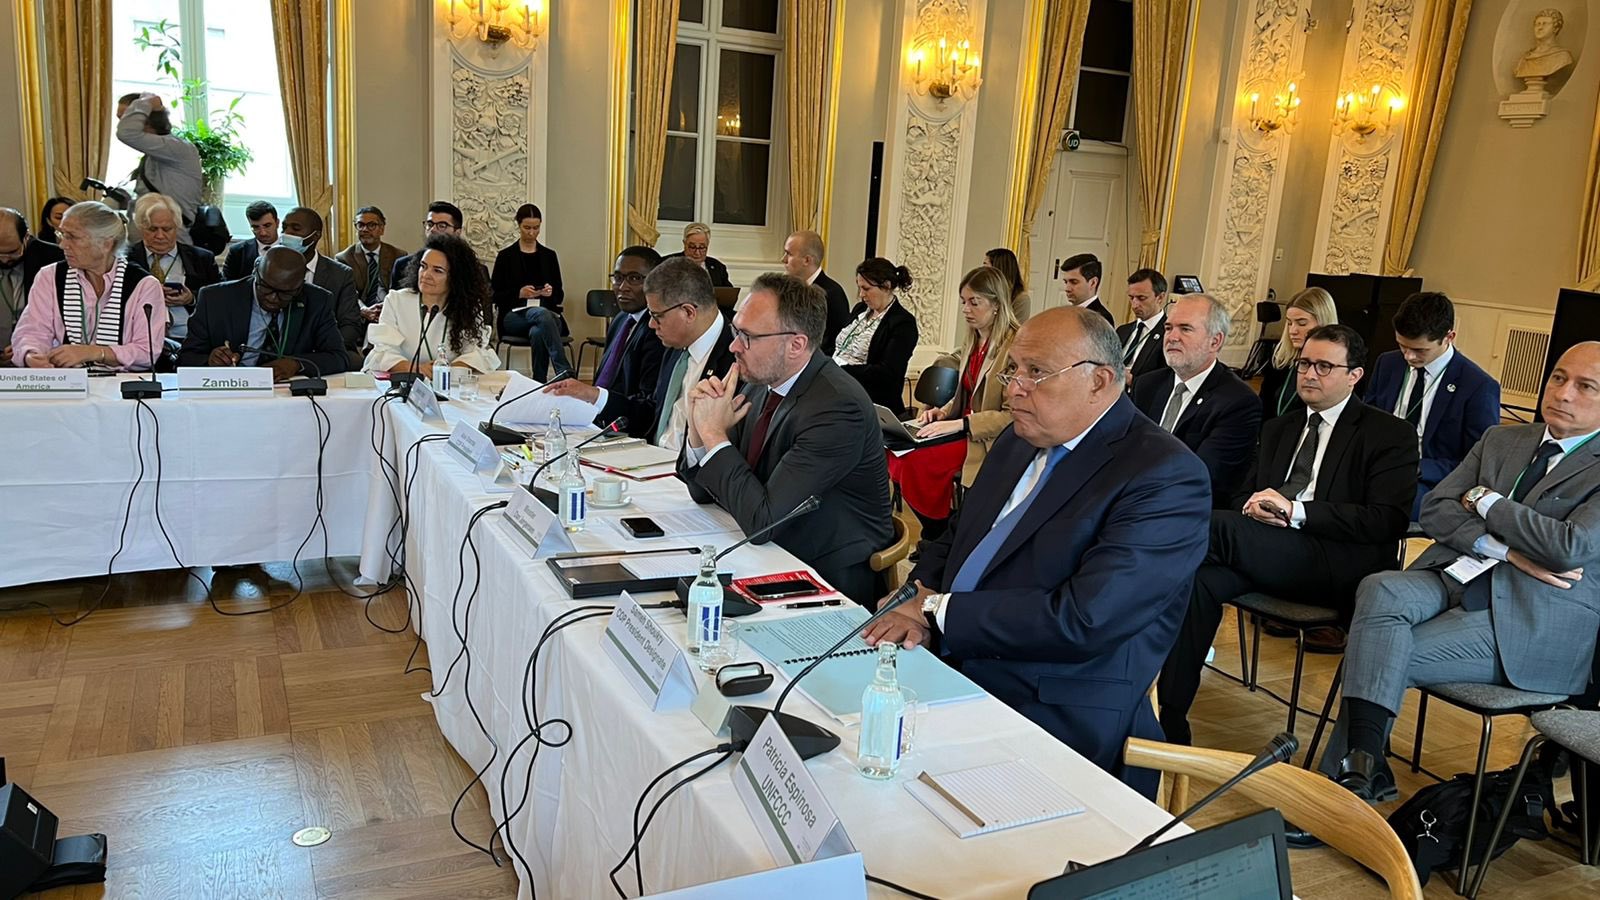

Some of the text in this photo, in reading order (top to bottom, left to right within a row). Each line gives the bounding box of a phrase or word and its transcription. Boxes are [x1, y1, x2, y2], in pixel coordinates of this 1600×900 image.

[0, 374, 67, 382] United States of
[16, 383, 51, 391] America
[202, 378, 249, 388] Zambia
[624, 617, 647, 646] President
[643, 639, 667, 671] Designate
[762, 736, 789, 780] Patricia
[783, 771, 817, 829] Espinosa
[761, 774, 792, 826] UNFCCC
